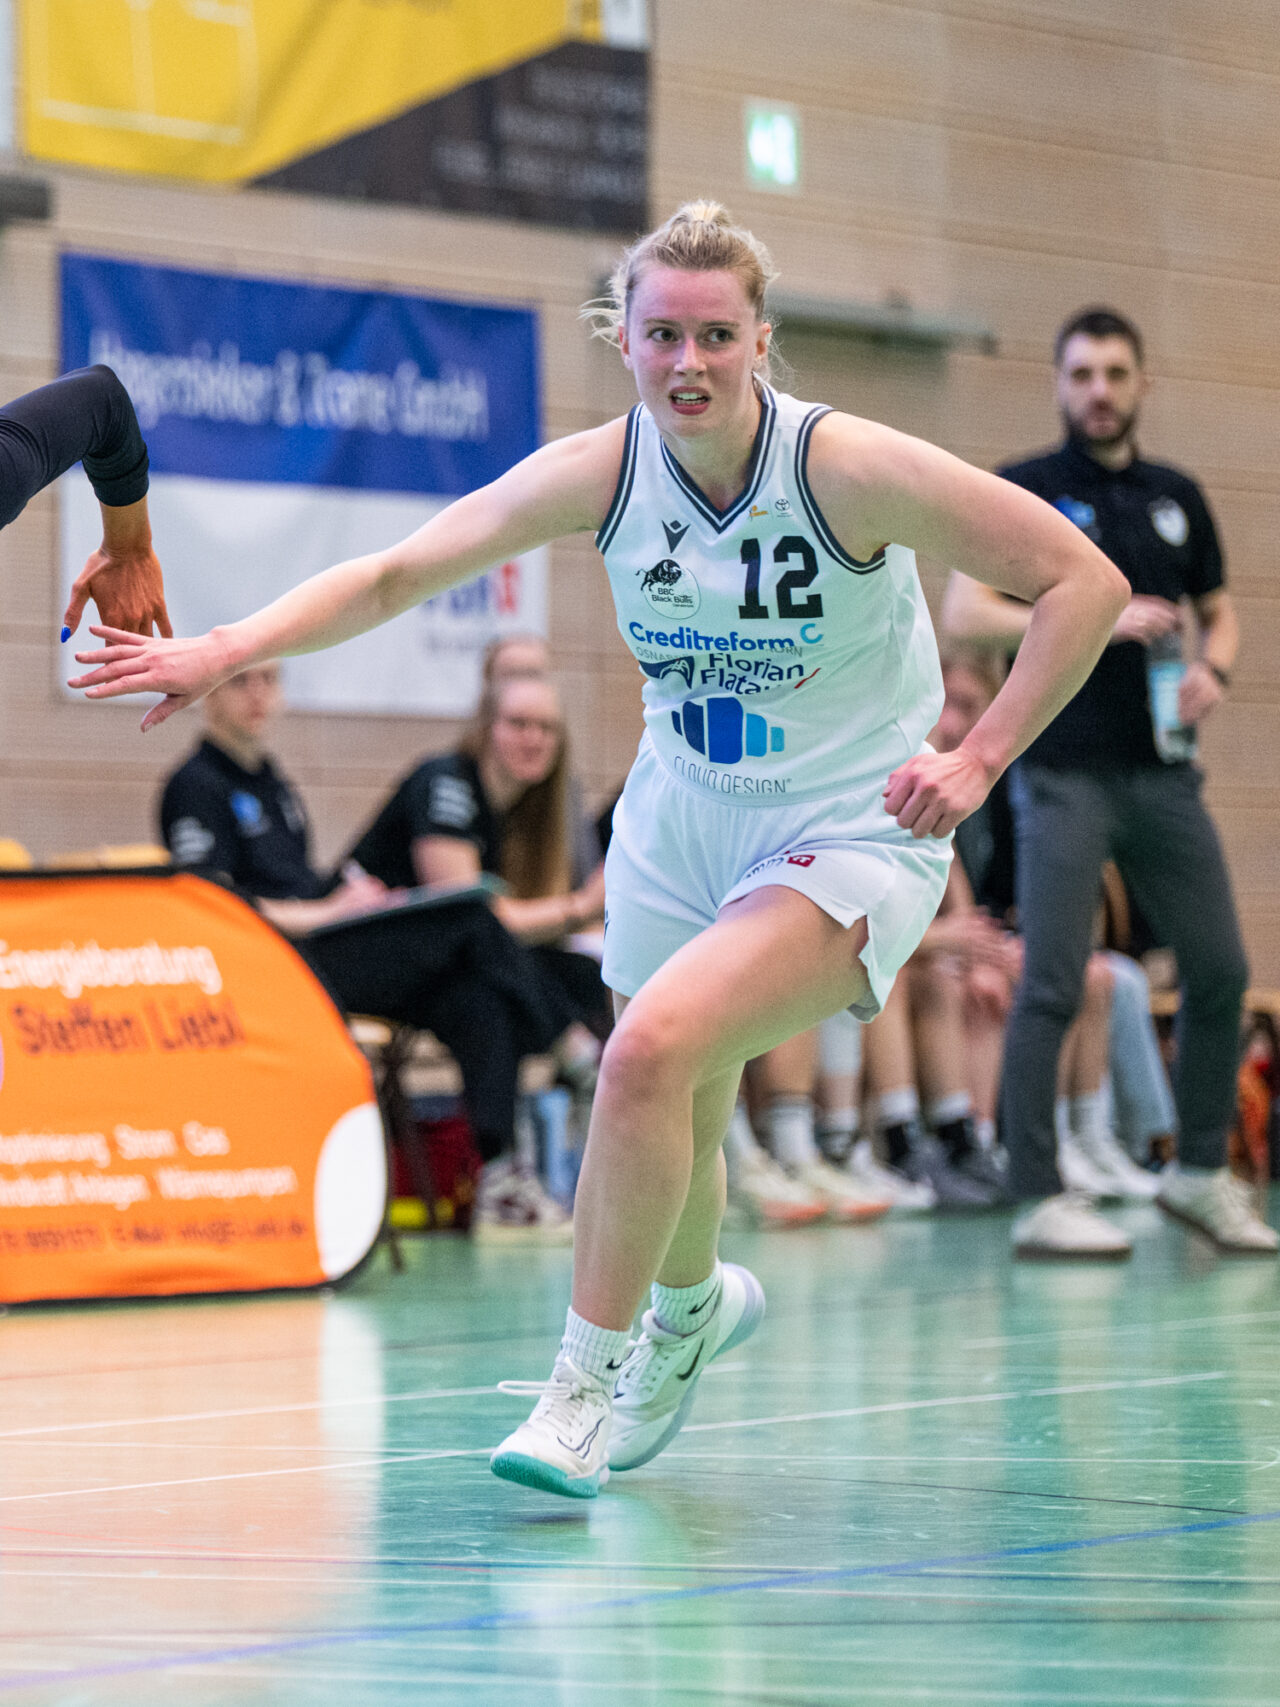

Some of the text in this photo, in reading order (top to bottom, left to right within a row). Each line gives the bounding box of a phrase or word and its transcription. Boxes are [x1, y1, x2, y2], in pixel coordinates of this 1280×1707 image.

[738, 536, 823, 619] 12
[651, 594, 673, 603] Black
[658, 588, 674, 596] BBC
[629, 621, 795, 651] Creditreform
[709, 653, 804, 681] Florian
[700, 668, 782, 695] Flata
[673, 755, 718, 790] CLOUD
